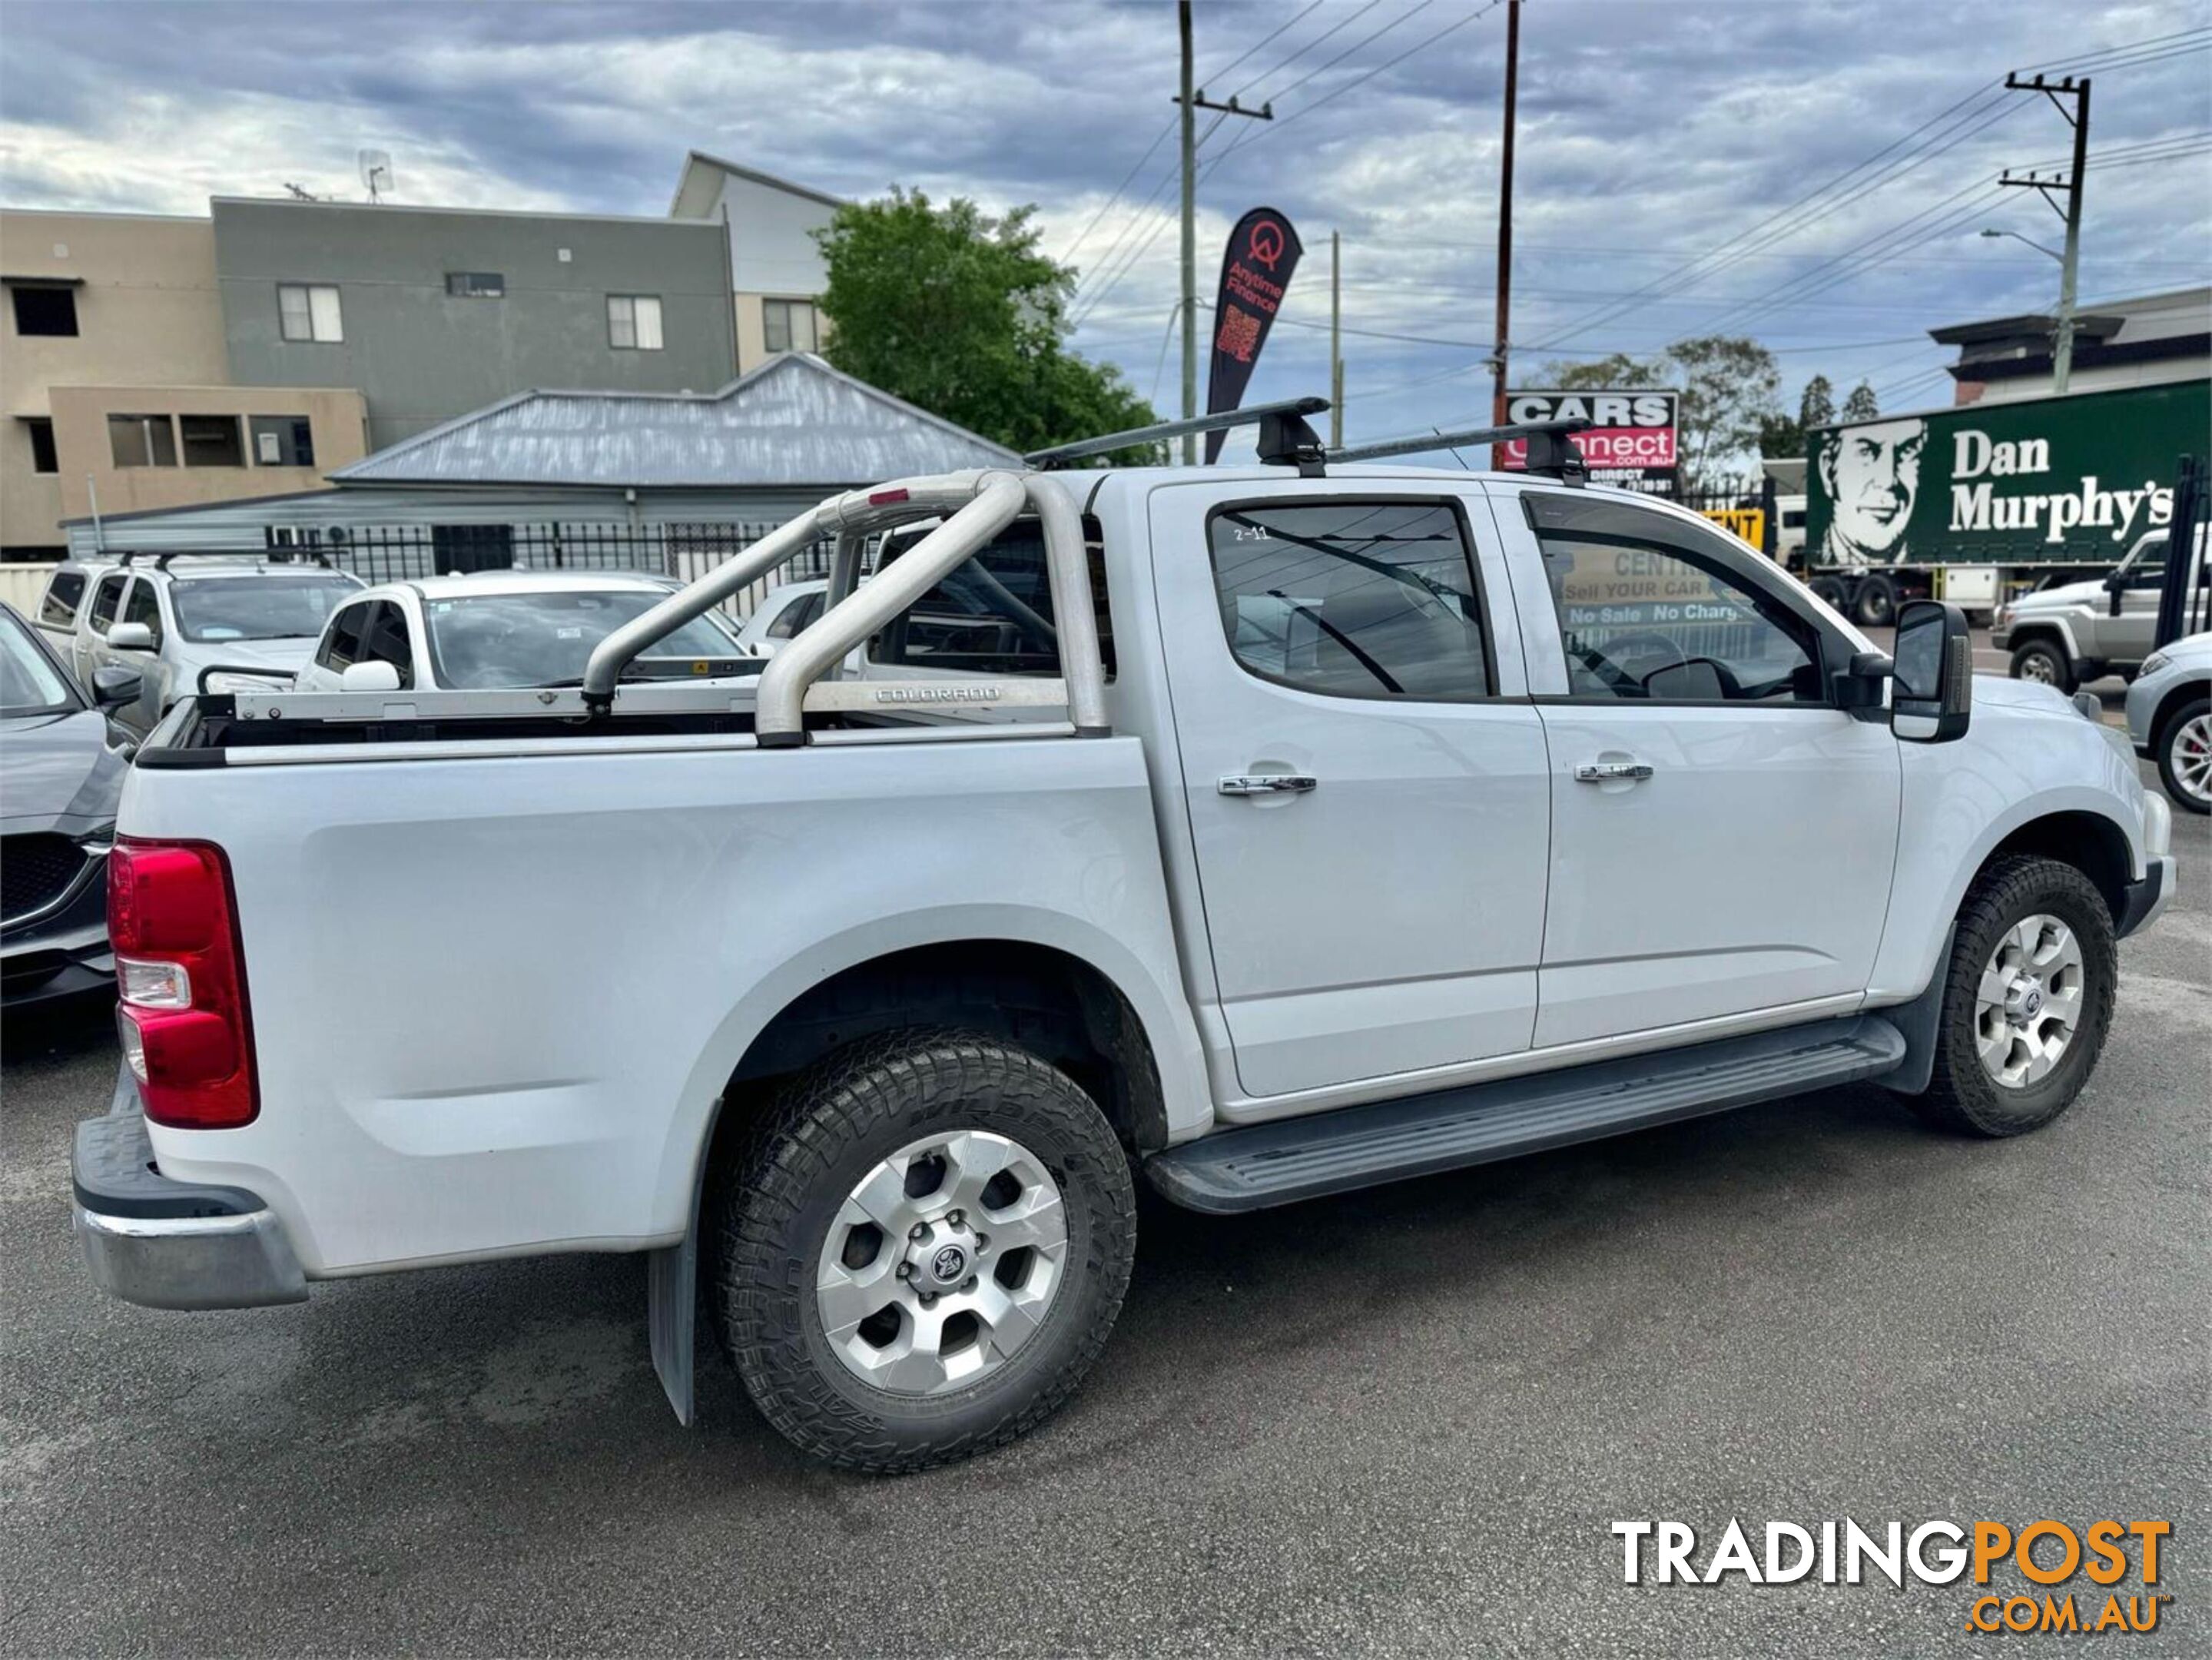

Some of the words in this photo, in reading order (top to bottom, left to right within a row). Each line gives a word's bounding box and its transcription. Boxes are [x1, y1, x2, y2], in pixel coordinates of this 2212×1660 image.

[1229, 262, 1282, 298] Anytime
[1226, 277, 1276, 313] Finance
[1509, 397, 1670, 427] CARS
[1951, 430, 2050, 479] Dan
[1590, 470, 1646, 480] DIRECT
[1948, 476, 2174, 543] Murphy's
[1234, 526, 1272, 541] 2-11
[1565, 584, 1598, 600] Sell
[1606, 581, 1657, 598] YOUR
[1664, 580, 1702, 596] CAR
[1570, 608, 1596, 623] No
[1600, 607, 1642, 622] Sale
[1653, 604, 1680, 621] No
[1685, 603, 1743, 621] Charg
[877, 686, 1000, 702] COLORADO
